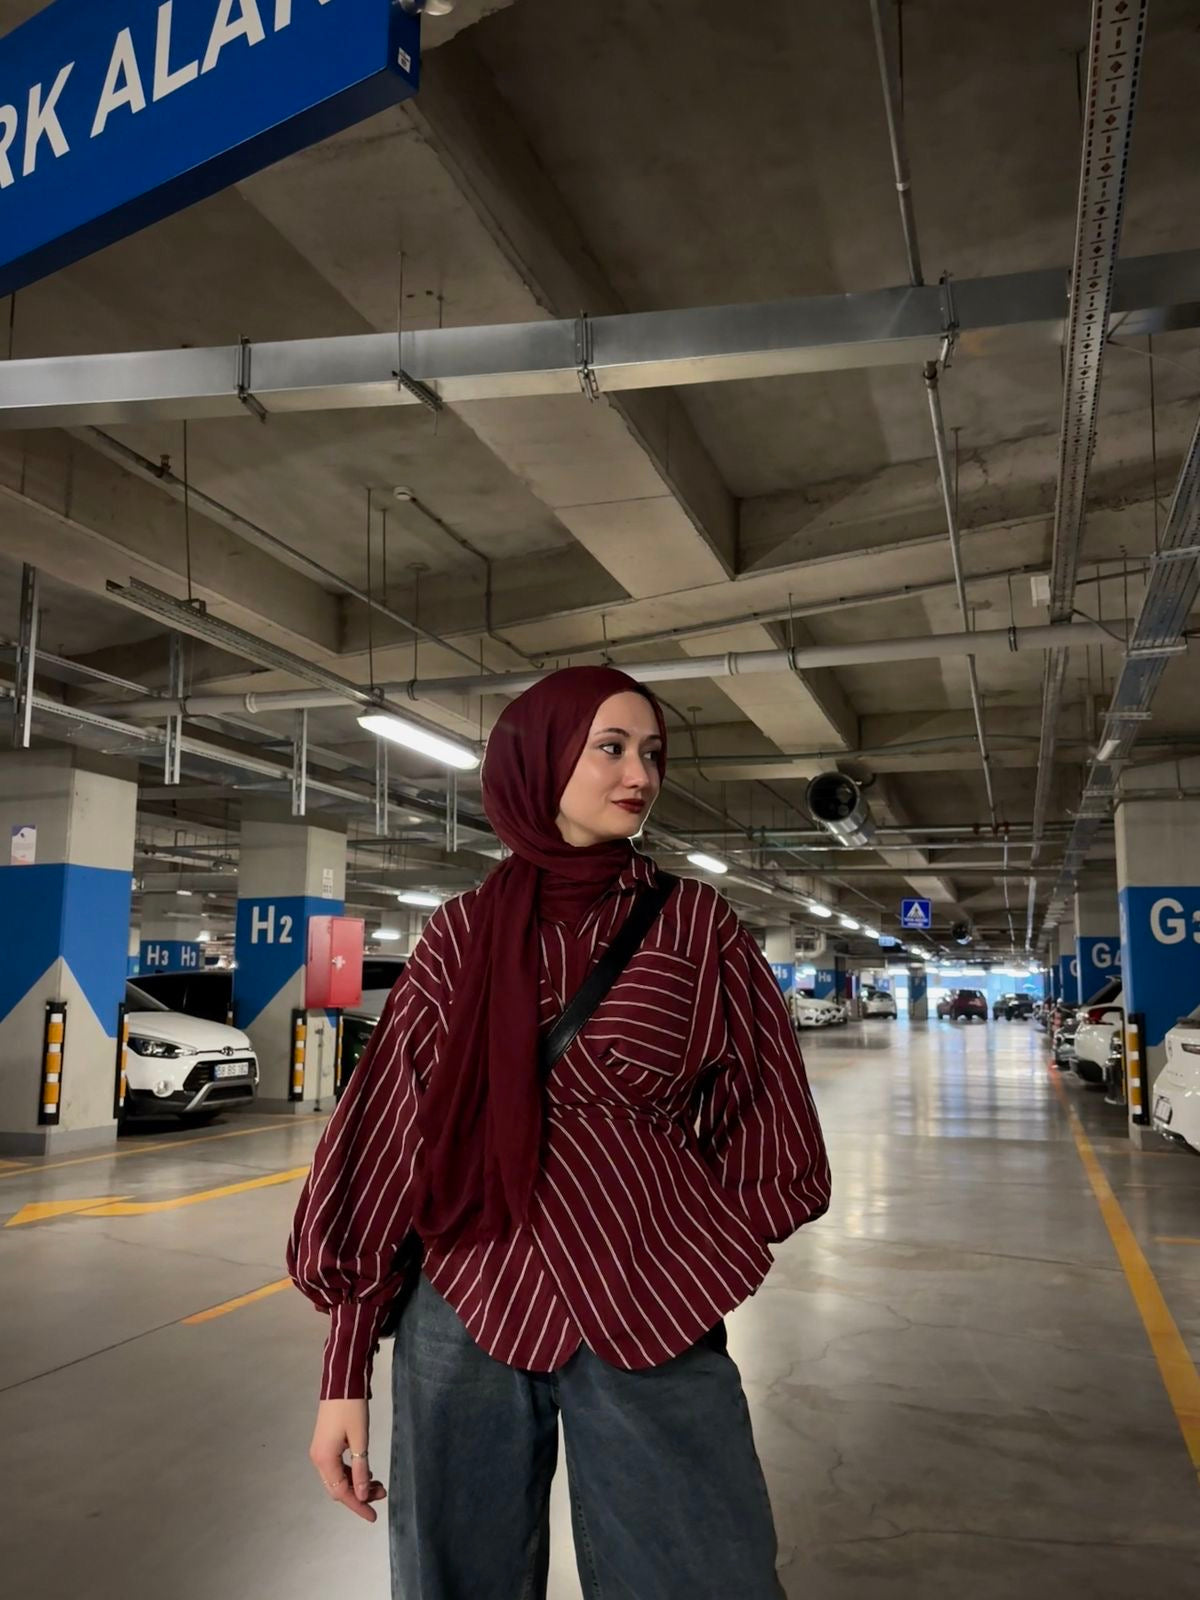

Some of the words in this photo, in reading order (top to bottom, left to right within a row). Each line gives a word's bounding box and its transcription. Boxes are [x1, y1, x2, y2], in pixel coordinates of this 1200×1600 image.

[90, 0, 331, 138] ALA
[251, 905, 293, 944] H2
[146, 944, 169, 966] H3
[180, 945, 197, 967] H3
